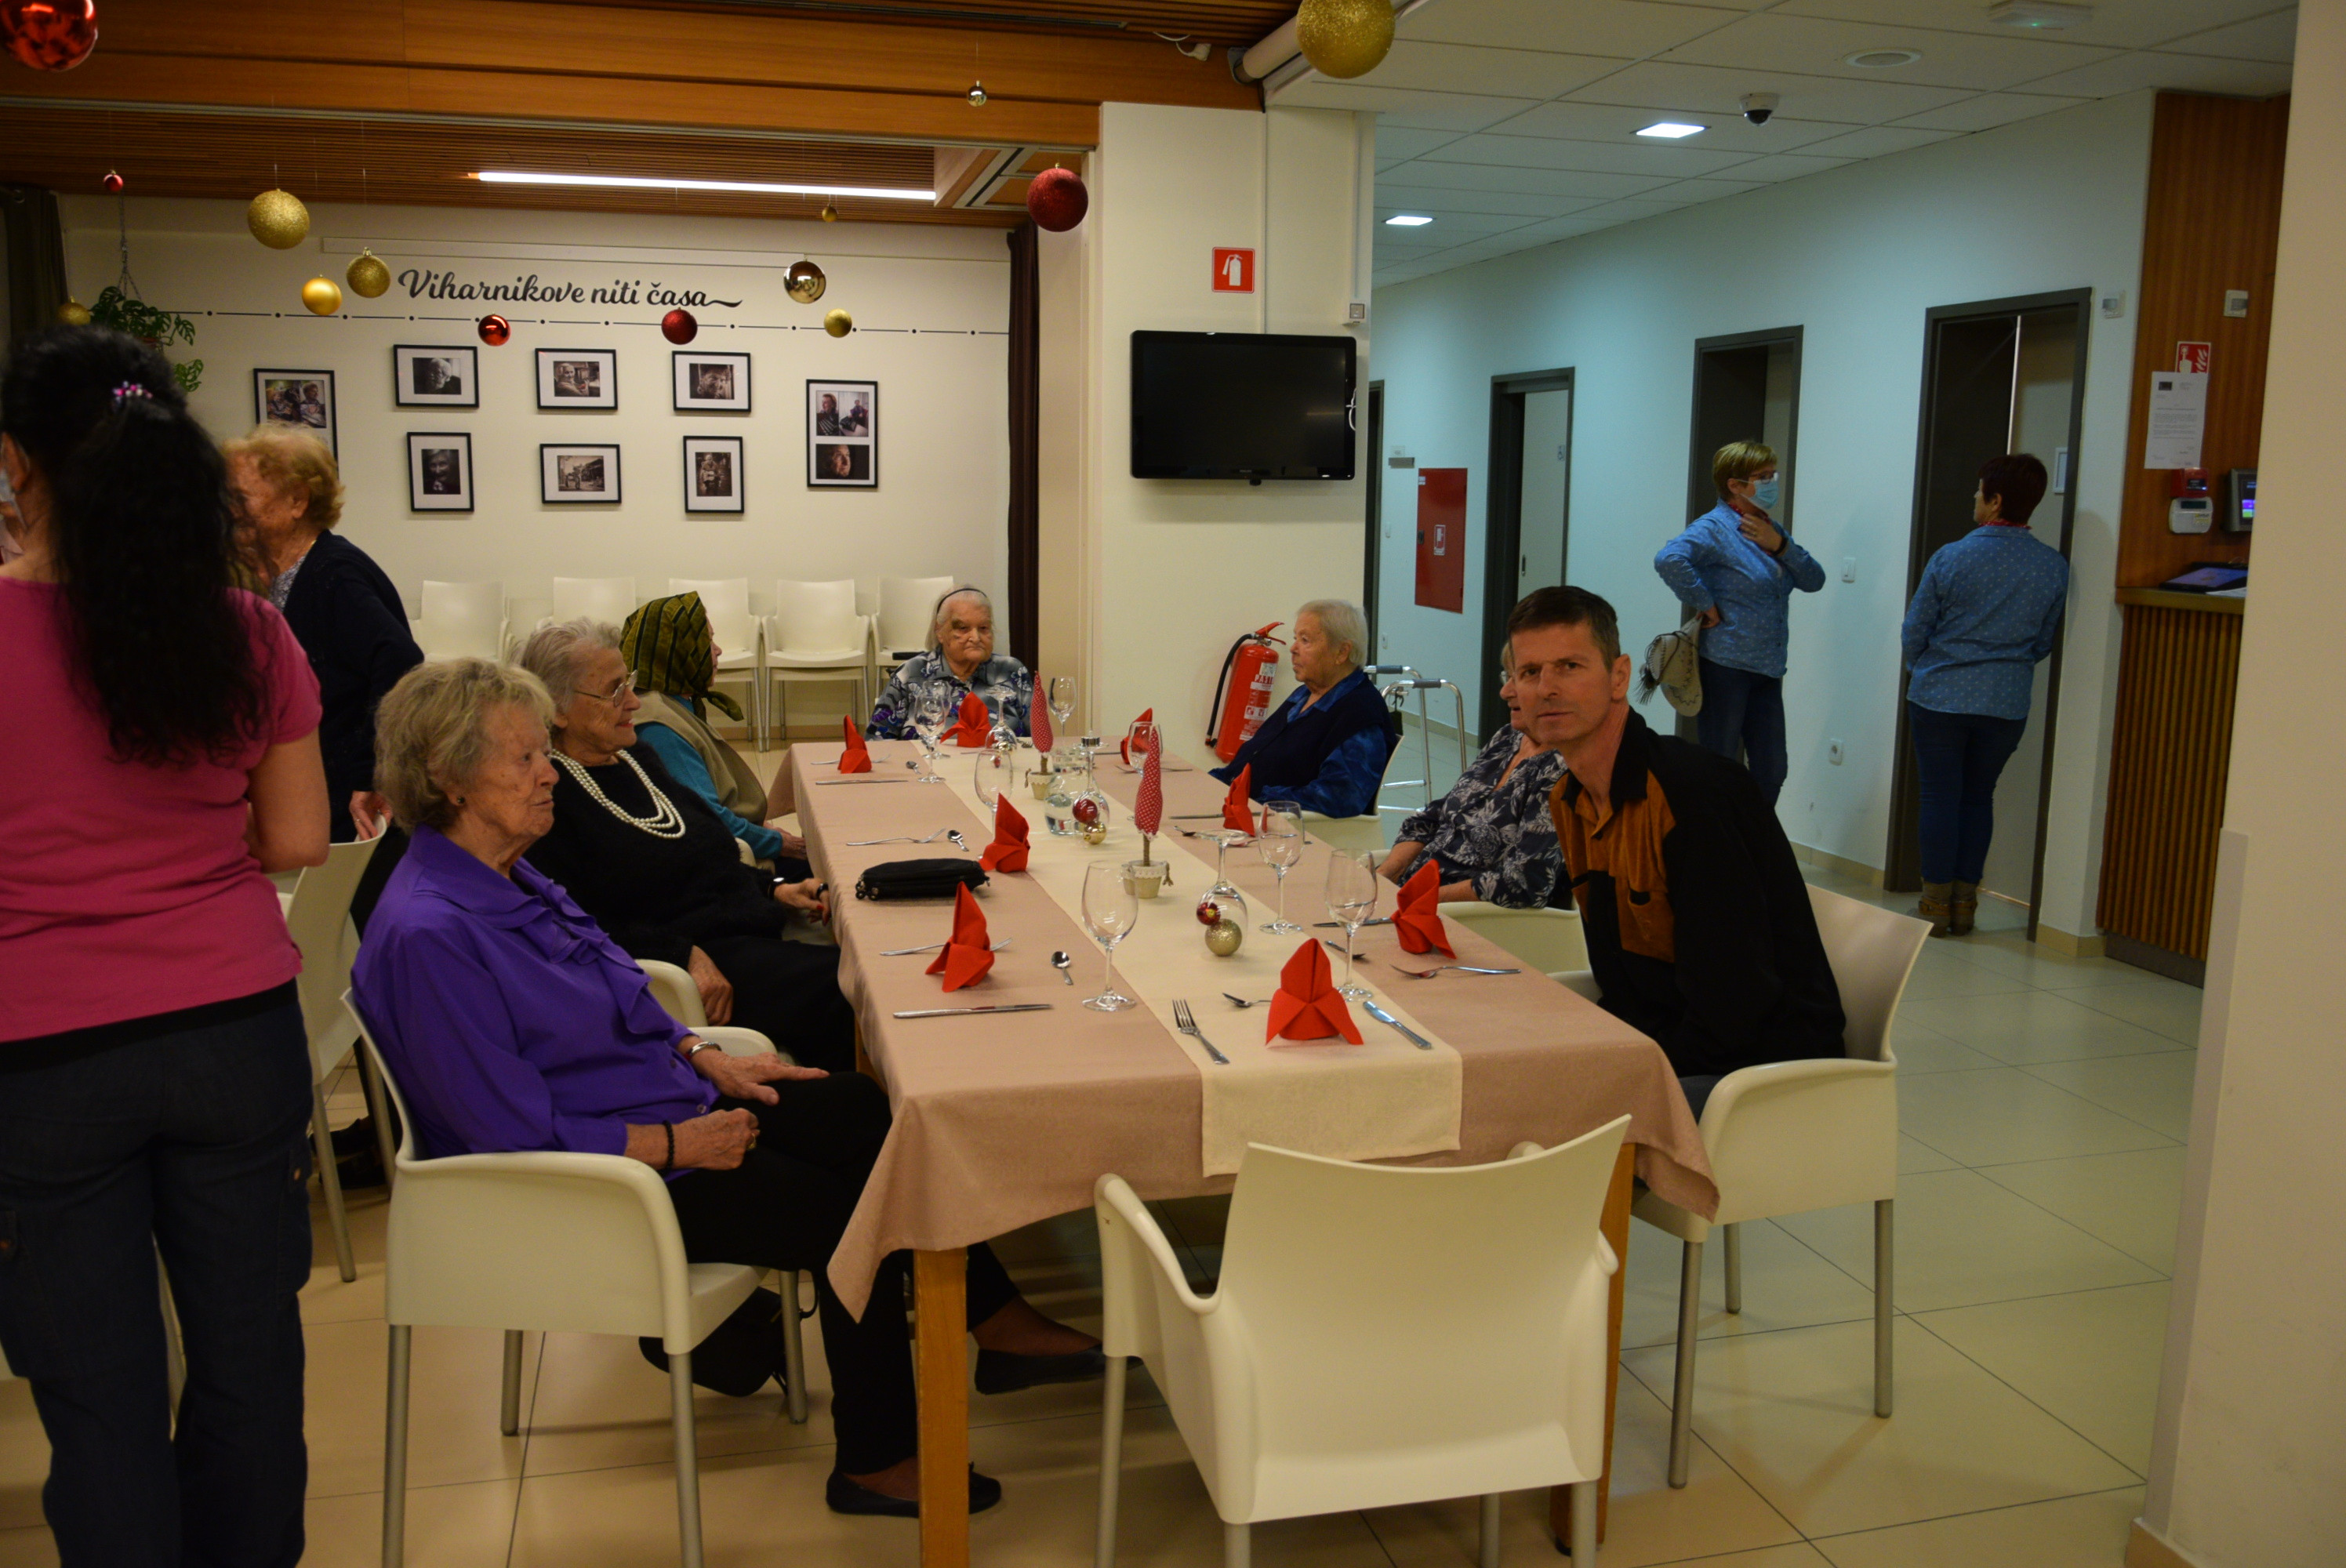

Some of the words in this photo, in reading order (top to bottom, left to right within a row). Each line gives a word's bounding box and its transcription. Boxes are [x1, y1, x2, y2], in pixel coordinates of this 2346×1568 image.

[398, 269, 586, 303] Viharnikove
[590, 279, 640, 304] niti
[646, 281, 743, 307] časa
